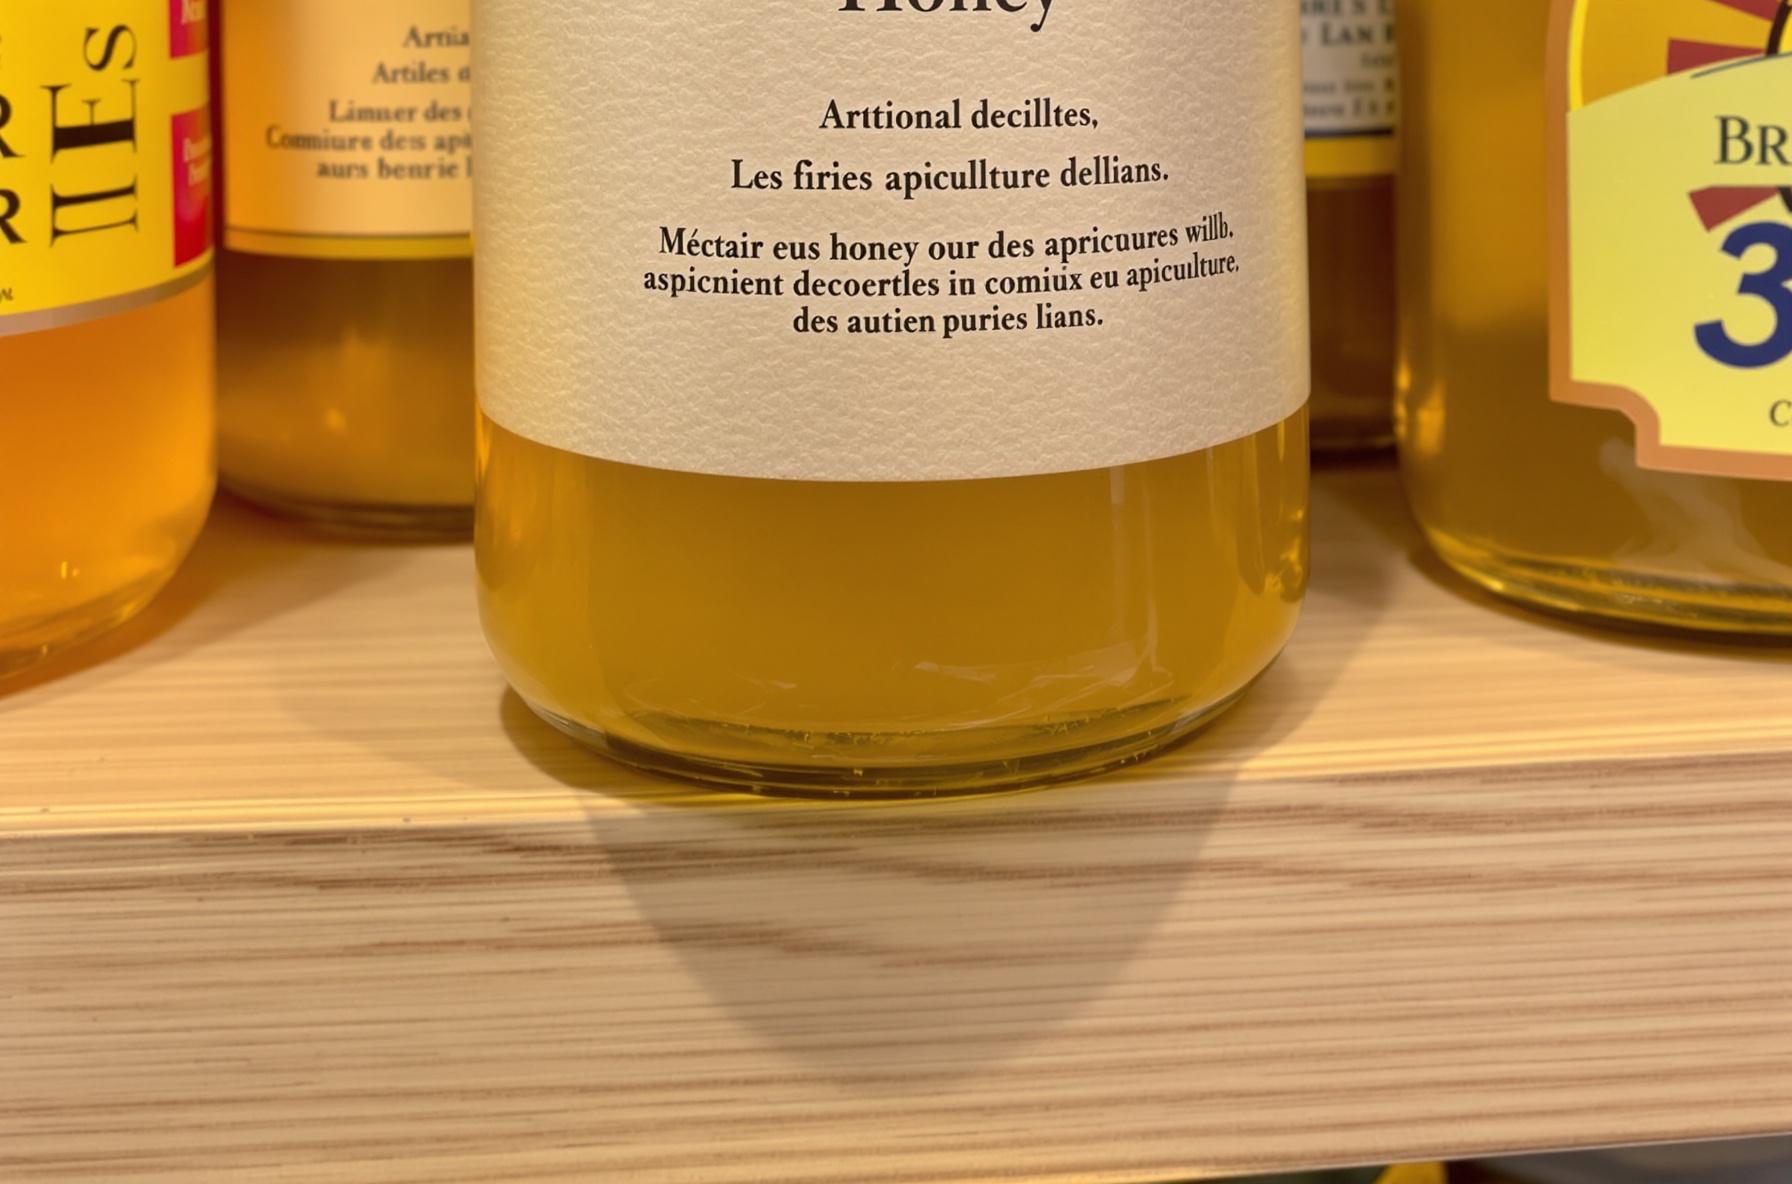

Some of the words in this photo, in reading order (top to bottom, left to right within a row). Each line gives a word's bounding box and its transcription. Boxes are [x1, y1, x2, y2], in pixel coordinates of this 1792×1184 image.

[730, 158, 784, 190] Les
[792, 158, 874, 191] firies
[1059, 154, 1170, 188] dellians.
[658, 225, 765, 259] Méctair
[772, 240, 822, 261] eus
[829, 231, 920, 268] honey
[927, 239, 980, 261] our
[987, 229, 1036, 259] des
[1089, 270, 1121, 291] eu
[792, 304, 839, 334] des
[846, 306, 937, 334] autien
[941, 303, 1029, 340] puries
[1035, 301, 1104, 331] lians.
